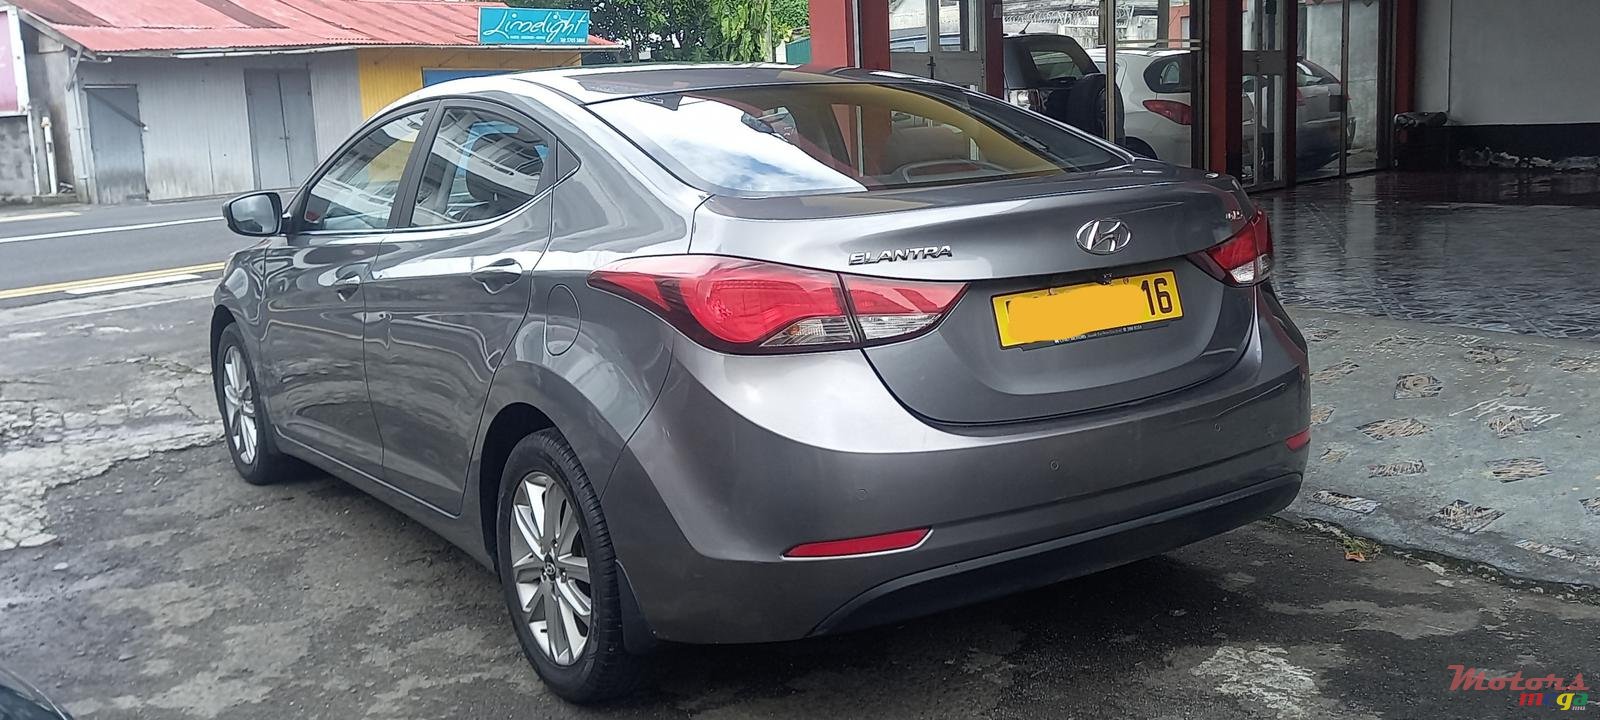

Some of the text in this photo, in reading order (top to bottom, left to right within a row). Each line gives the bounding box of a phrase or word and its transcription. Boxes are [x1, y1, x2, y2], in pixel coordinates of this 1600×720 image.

[483, 10, 587, 43] Limelight
[849, 245, 953, 266] ELANTRA
[1140, 277, 1173, 316] 16
